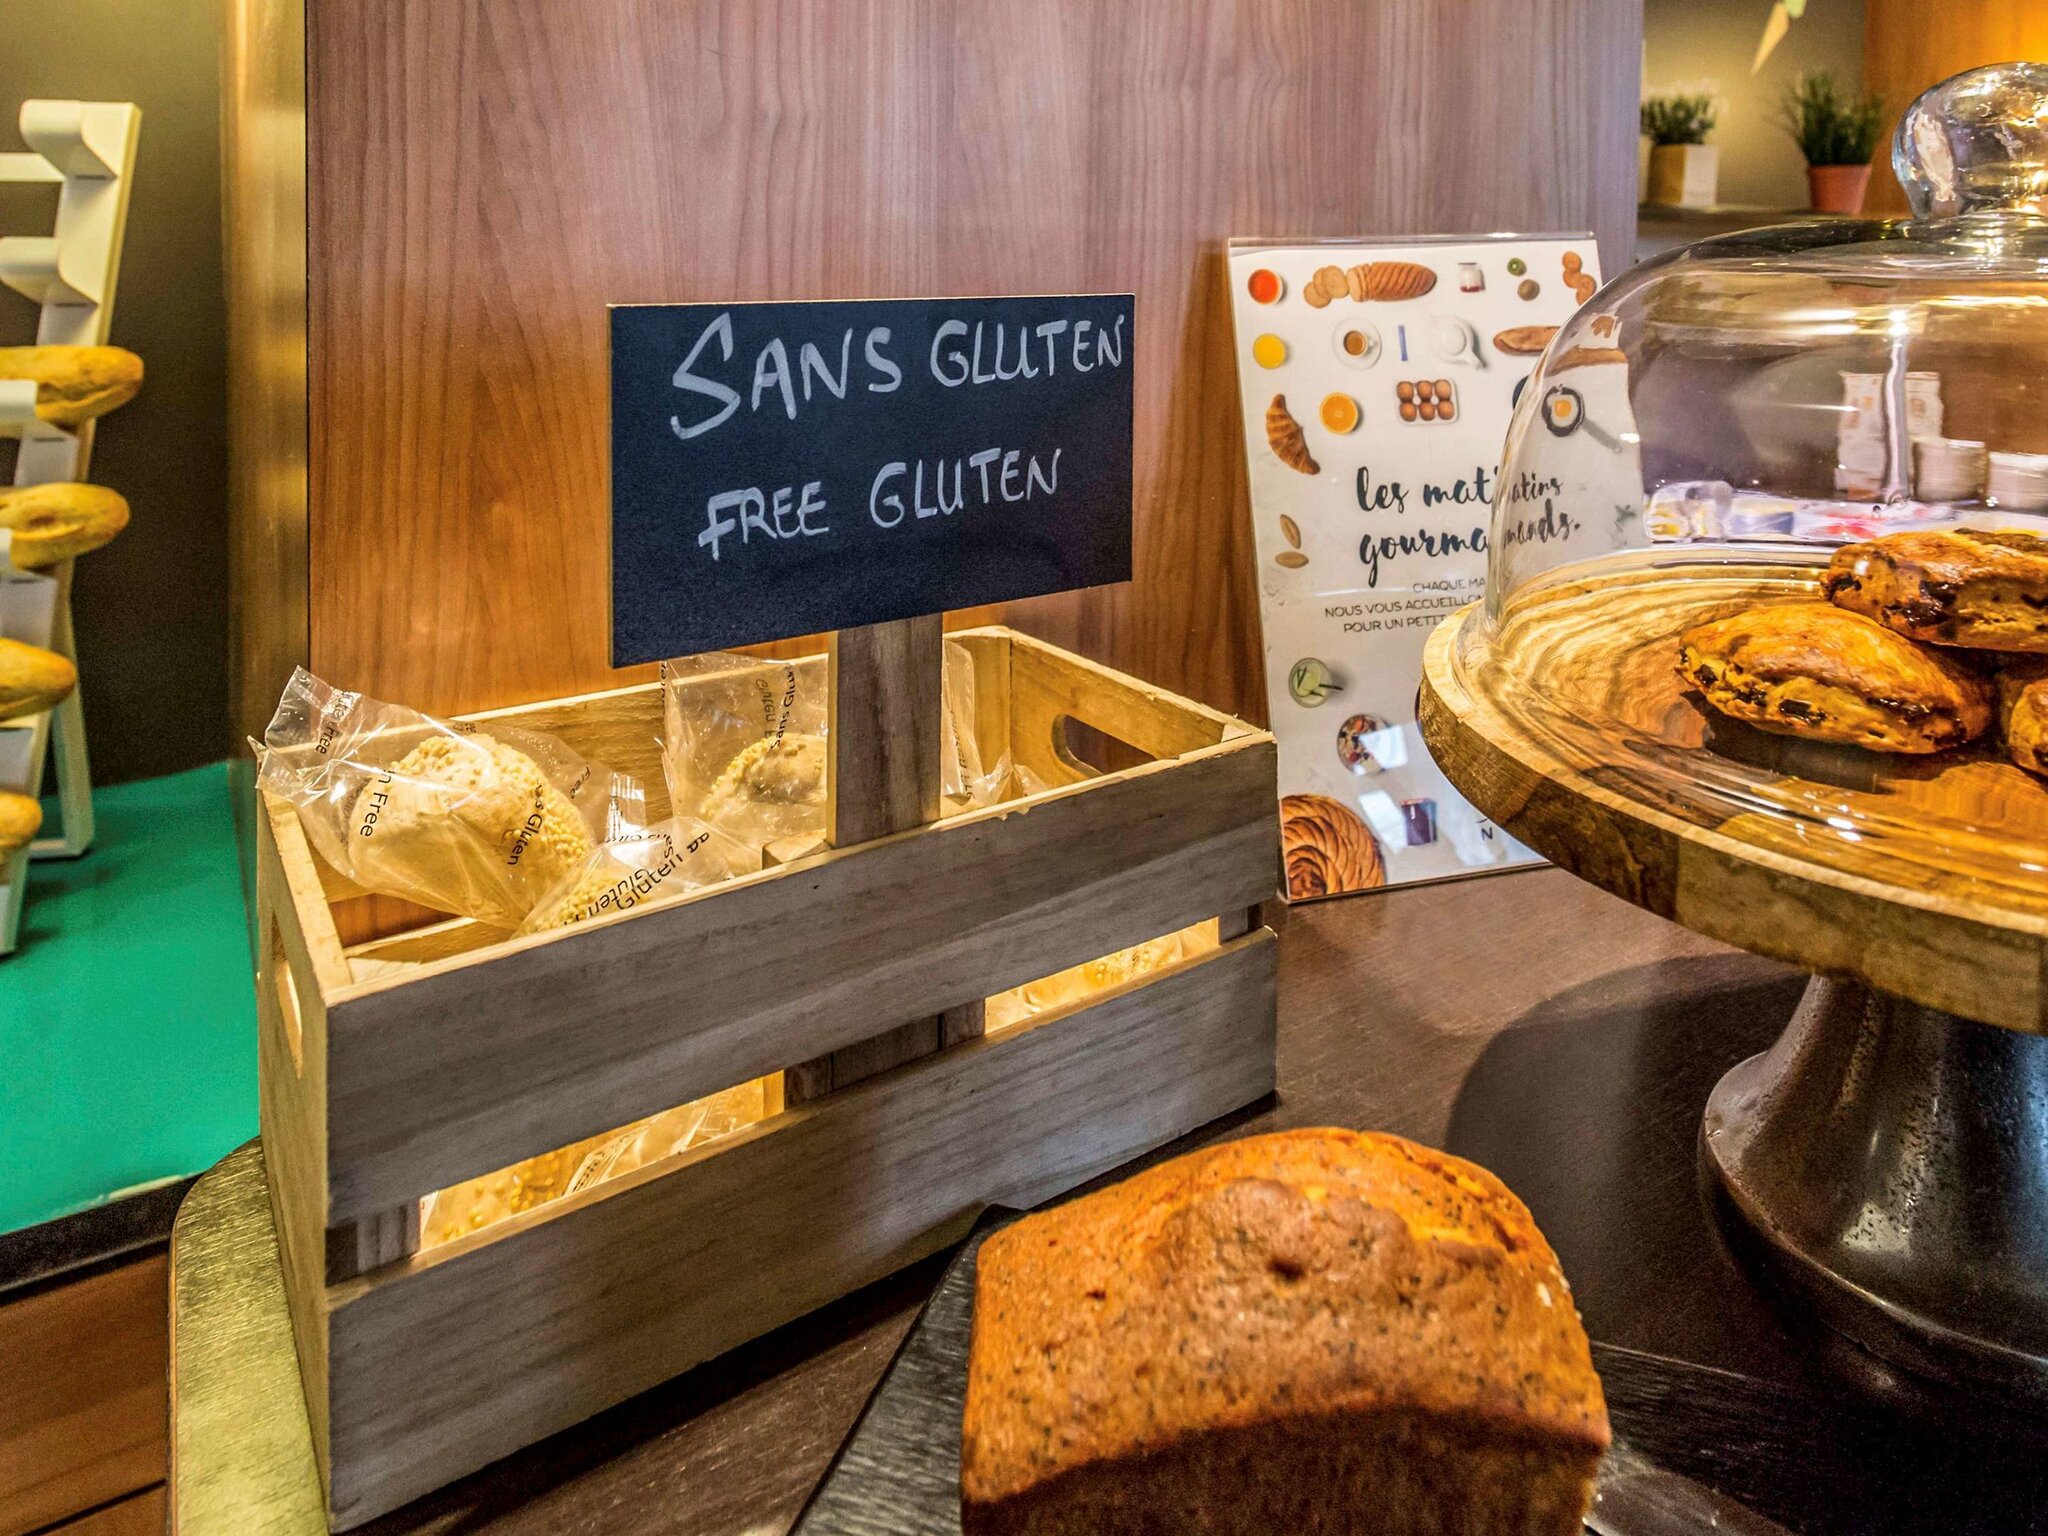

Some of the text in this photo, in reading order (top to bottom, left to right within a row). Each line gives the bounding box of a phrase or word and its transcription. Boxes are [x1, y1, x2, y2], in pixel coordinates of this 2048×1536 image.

[670, 312, 1127, 440] SANS GLUTEN
[698, 447, 1062, 562] FREE GLUTEN
[1356, 465, 1410, 514] les
[1324, 594, 1482, 618] NOUS VOUS ACCUEILLO
[1412, 577, 1486, 593] CHAQUE MA
[1343, 619, 1382, 634] POUR
[1384, 617, 1404, 630] UN
[360, 792, 389, 837] Free
[507, 813, 543, 866] Gluten
